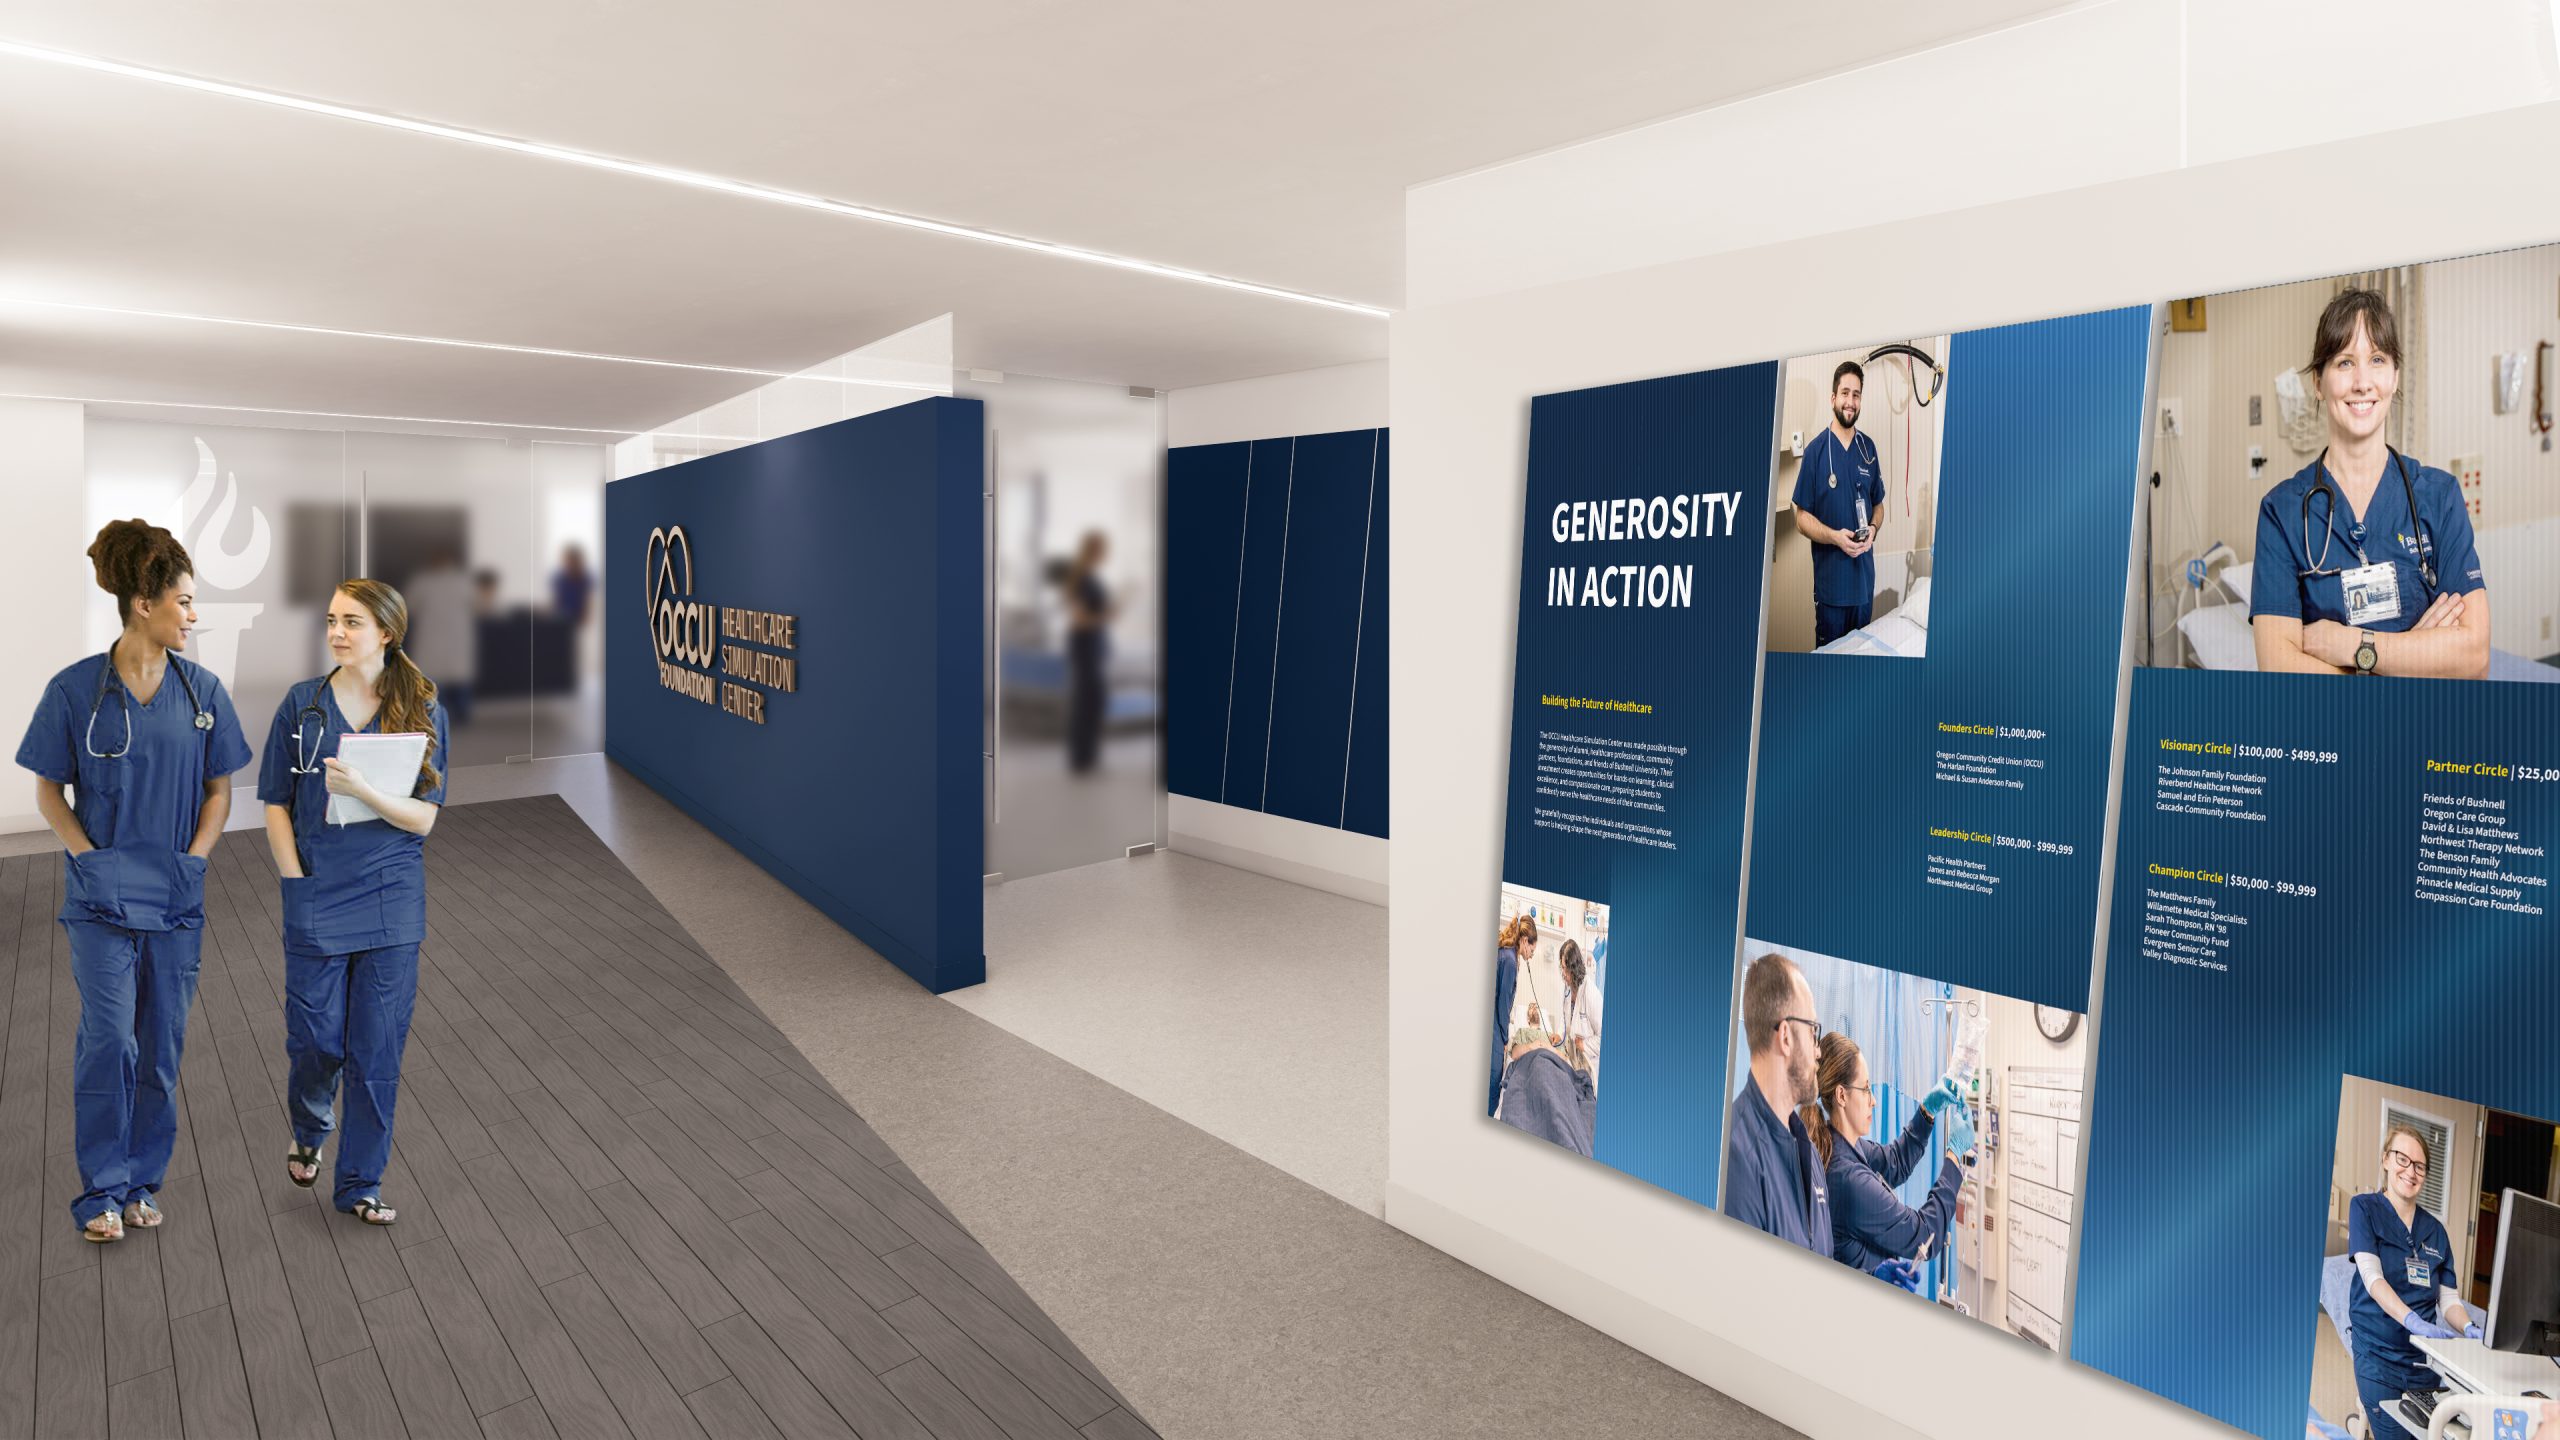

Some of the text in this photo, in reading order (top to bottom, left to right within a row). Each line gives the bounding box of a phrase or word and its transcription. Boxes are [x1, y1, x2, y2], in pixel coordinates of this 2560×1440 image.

[1552, 492, 1742, 543] GENEROSITY
[1548, 565, 1693, 608] IN ACTION
[660, 599, 716, 669] OCCU
[722, 607, 795, 649] HEALTHCARE
[722, 644, 796, 692] SIMULATION
[660, 661, 716, 705] FOUNDATION
[722, 682, 765, 724] CENTER
[1542, 694, 1652, 714] Building the Future of Healthcare
[1938, 722, 1972, 734] Founders
[1973, 724, 1994, 735] Circle
[2000, 726, 2046, 740] $1,000,000+
[1549, 732, 1560, 740] OCCU
[1561, 733, 1583, 743] Healthcare
[1584, 736, 1607, 745] Simulation
[1608, 739, 1623, 747] Center
[1633, 741, 1646, 750] made
[1647, 743, 1667, 752] possible
[1667, 744, 1687, 756] through
[2160, 739, 2203, 755] Visionary
[2205, 742, 2231, 755] Circle
[2239, 745, 2283, 759] $100,000
[2291, 749, 2338, 764] $499,999
[1936, 750, 2044, 769] Oregon Community Credit Union (OCCU)
[1937, 761, 1996, 774] The Harlan Foundation
[2427, 760, 2471, 774] Partner
[2474, 763, 2508, 777] Circle
[1936, 772, 1956, 781] Michael
[1961, 775, 1978, 784] Susan
[1979, 777, 2004, 787] Anderson
[2005, 780, 2024, 790] Family
[2158, 765, 2266, 783] The Johnson Family Foundation
[2158, 778, 2262, 795] Riverbend Healthcare Network
[2157, 790, 2243, 807] Samuel and Erin Peterson
[2423, 793, 2505, 810] Friends of Bushnell
[2156, 802, 2266, 822] Cascade Community Foundation
[2423, 808, 2506, 826] Oregon Care Group
[2422, 821, 2519, 839] David & Lisa Matthews
[1930, 826, 1969, 842] Leadership
[1970, 832, 1991, 844] Circle
[1996, 835, 2031, 849] $500,000
[2037, 840, 2073, 855] $999,999
[2421, 835, 2544, 857] Northwest Therapy Network
[1928, 854, 1986, 870] Pacific Health Partners
[2419, 849, 2500, 868] The Benson Family
[1928, 865, 2000, 885] James and Rebecca Morgan
[2149, 863, 2195, 880] Champion
[2197, 870, 2223, 884] Circle
[2230, 875, 2268, 890] $50,000
[2276, 881, 2316, 897] $99,999
[2418, 862, 2547, 887] Community Health Advocates
[1927, 876, 1993, 895] Northwest Medical Group
[2416, 876, 2521, 900] Pinnacle Medical Supply
[2147, 888, 2216, 908] The Matthews Family
[2415, 889, 2543, 915] Compassion Care Foundation
[2146, 913, 2165, 923] Sarah
[2166, 916, 2203, 931] Thompson,
[2205, 922, 2215, 931] RN
[2147, 902, 2247, 925] Willamette Medical Specialists
[2145, 925, 2229, 947] Pioneer Community Fund
[2144, 937, 2216, 958] Evergreen Senior Care
[2142, 948, 2227, 972] Valley Diagnostic Services
